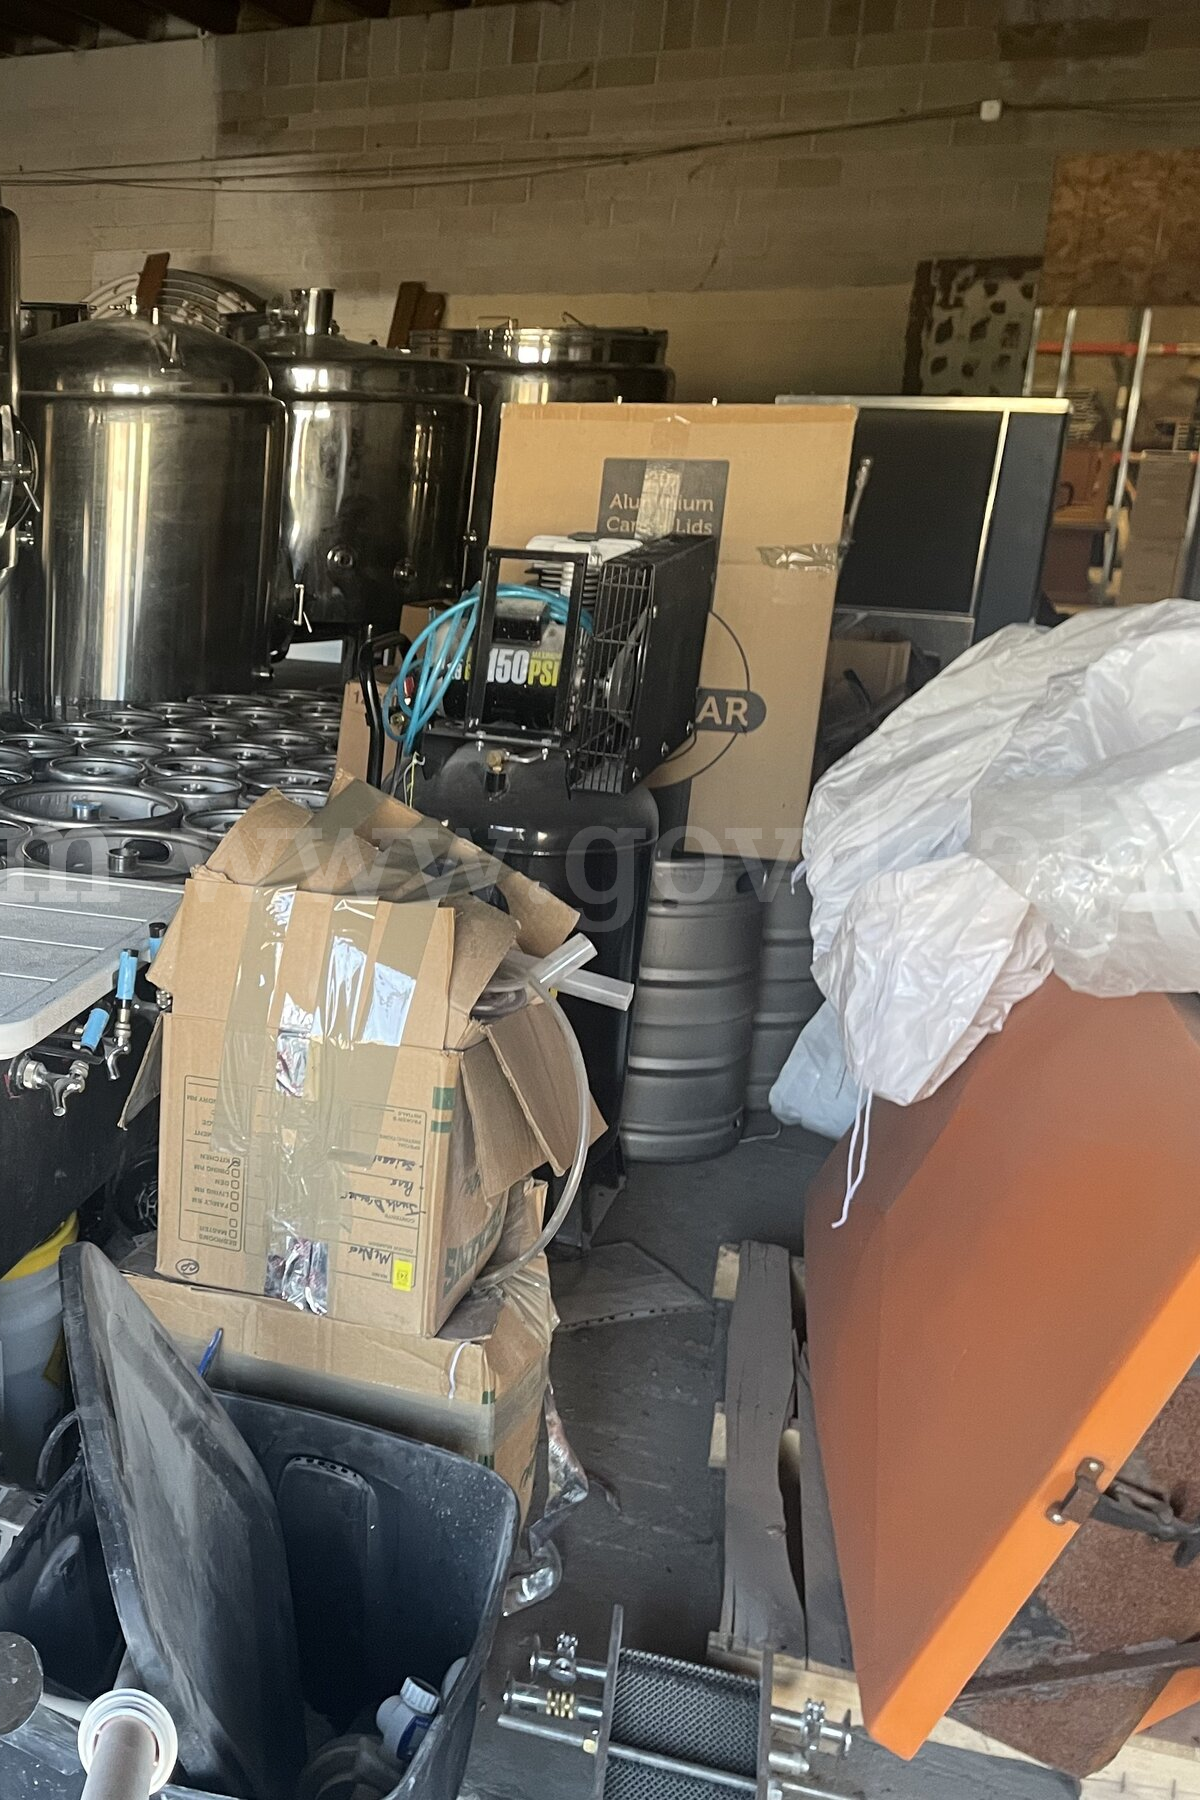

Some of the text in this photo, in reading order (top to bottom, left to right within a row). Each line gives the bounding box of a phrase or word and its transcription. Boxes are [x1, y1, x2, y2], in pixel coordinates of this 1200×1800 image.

[675, 517, 712, 535] Lids
[487, 647, 530, 685] 150
[527, 659, 561, 687] PSI
[200, 1153, 230, 1164] KITCHEN
[204, 1199, 229, 1210] FAMILY
